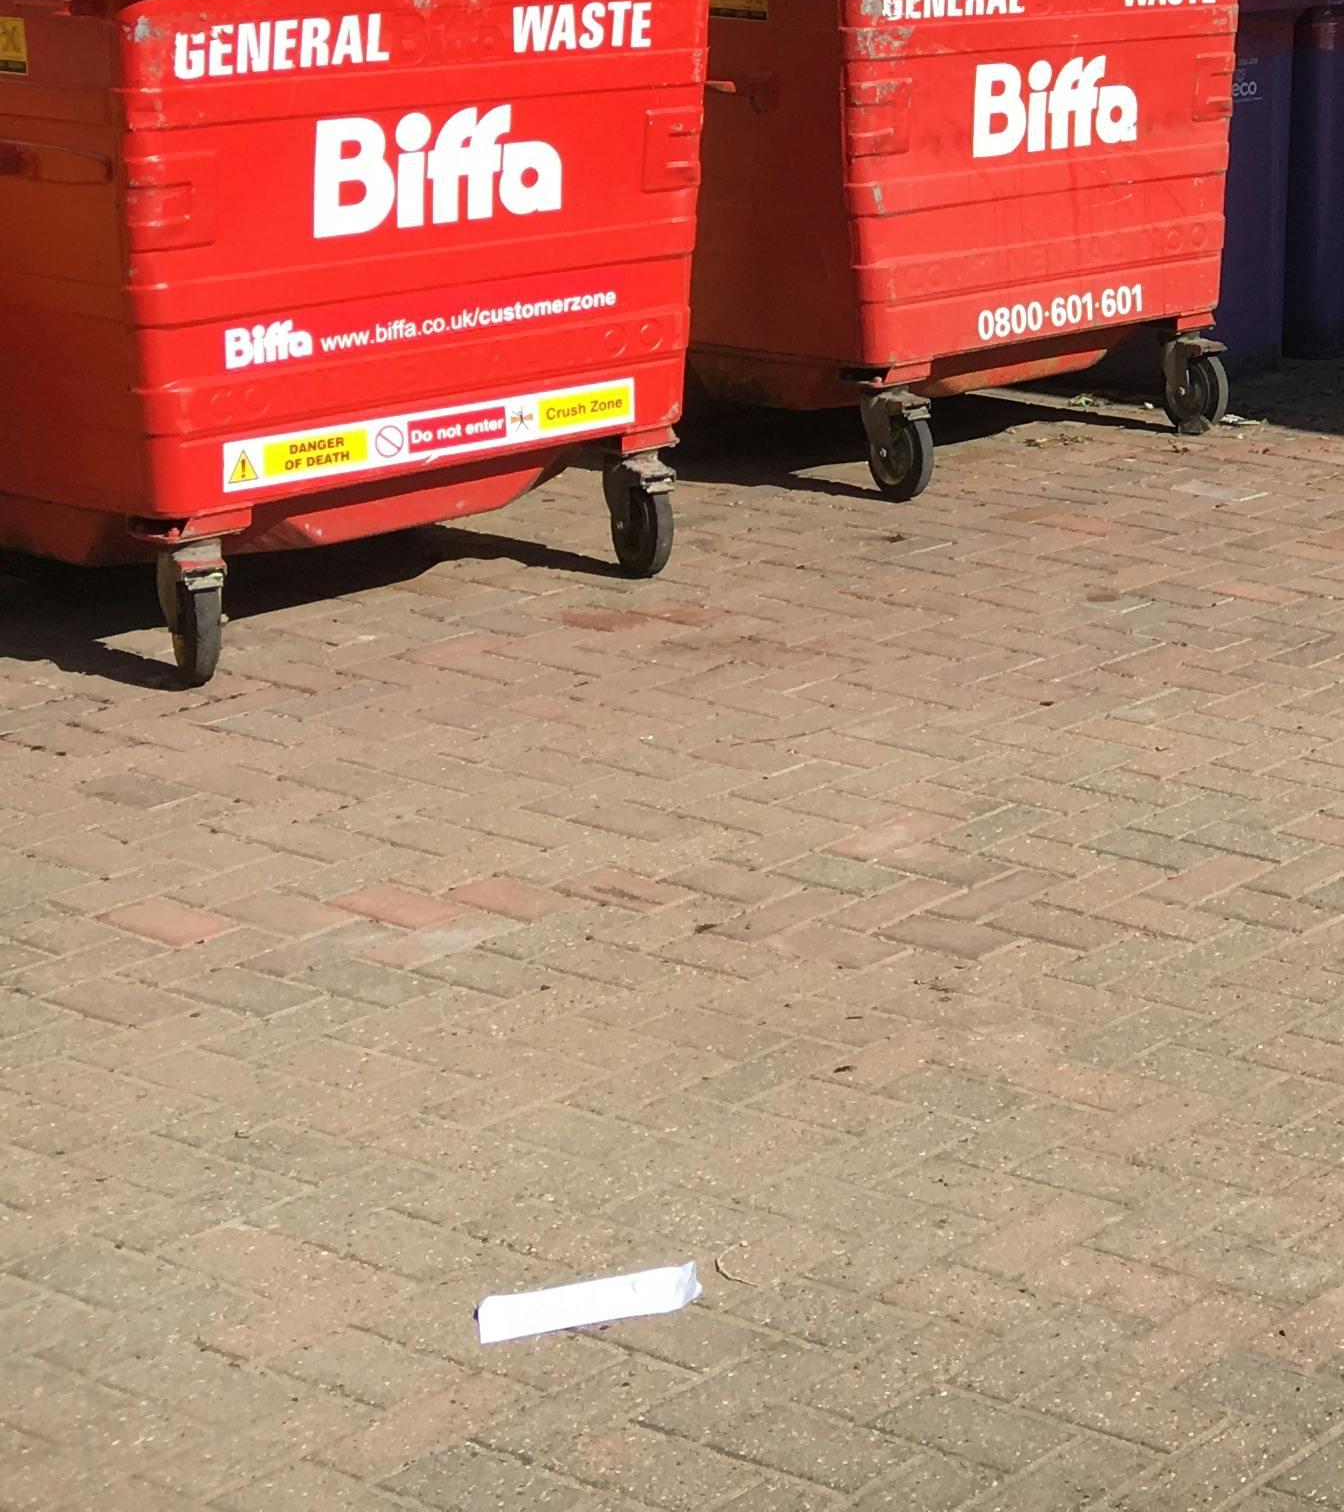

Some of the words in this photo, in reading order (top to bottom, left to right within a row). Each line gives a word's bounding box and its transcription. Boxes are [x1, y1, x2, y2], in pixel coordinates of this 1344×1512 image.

[173, 13, 390, 79] GENERAL
[512, 1, 653, 53] WASTE
[972, 54, 1138, 158] Biffa
[313, 104, 562, 239] Biffa
[225, 319, 313, 370] Biffa
[321, 290, 617, 353] www.biffa.co.uk/customerzone
[411, 428, 432, 445] Do
[437, 422, 461, 440] not
[465, 417, 504, 435] enter
[545, 405, 586, 422] Crush
[590, 396, 623, 413] Zone
[284, 458, 304, 471] OF
[306, 451, 350, 467] DEATH
[288, 437, 345, 455] DANGER
